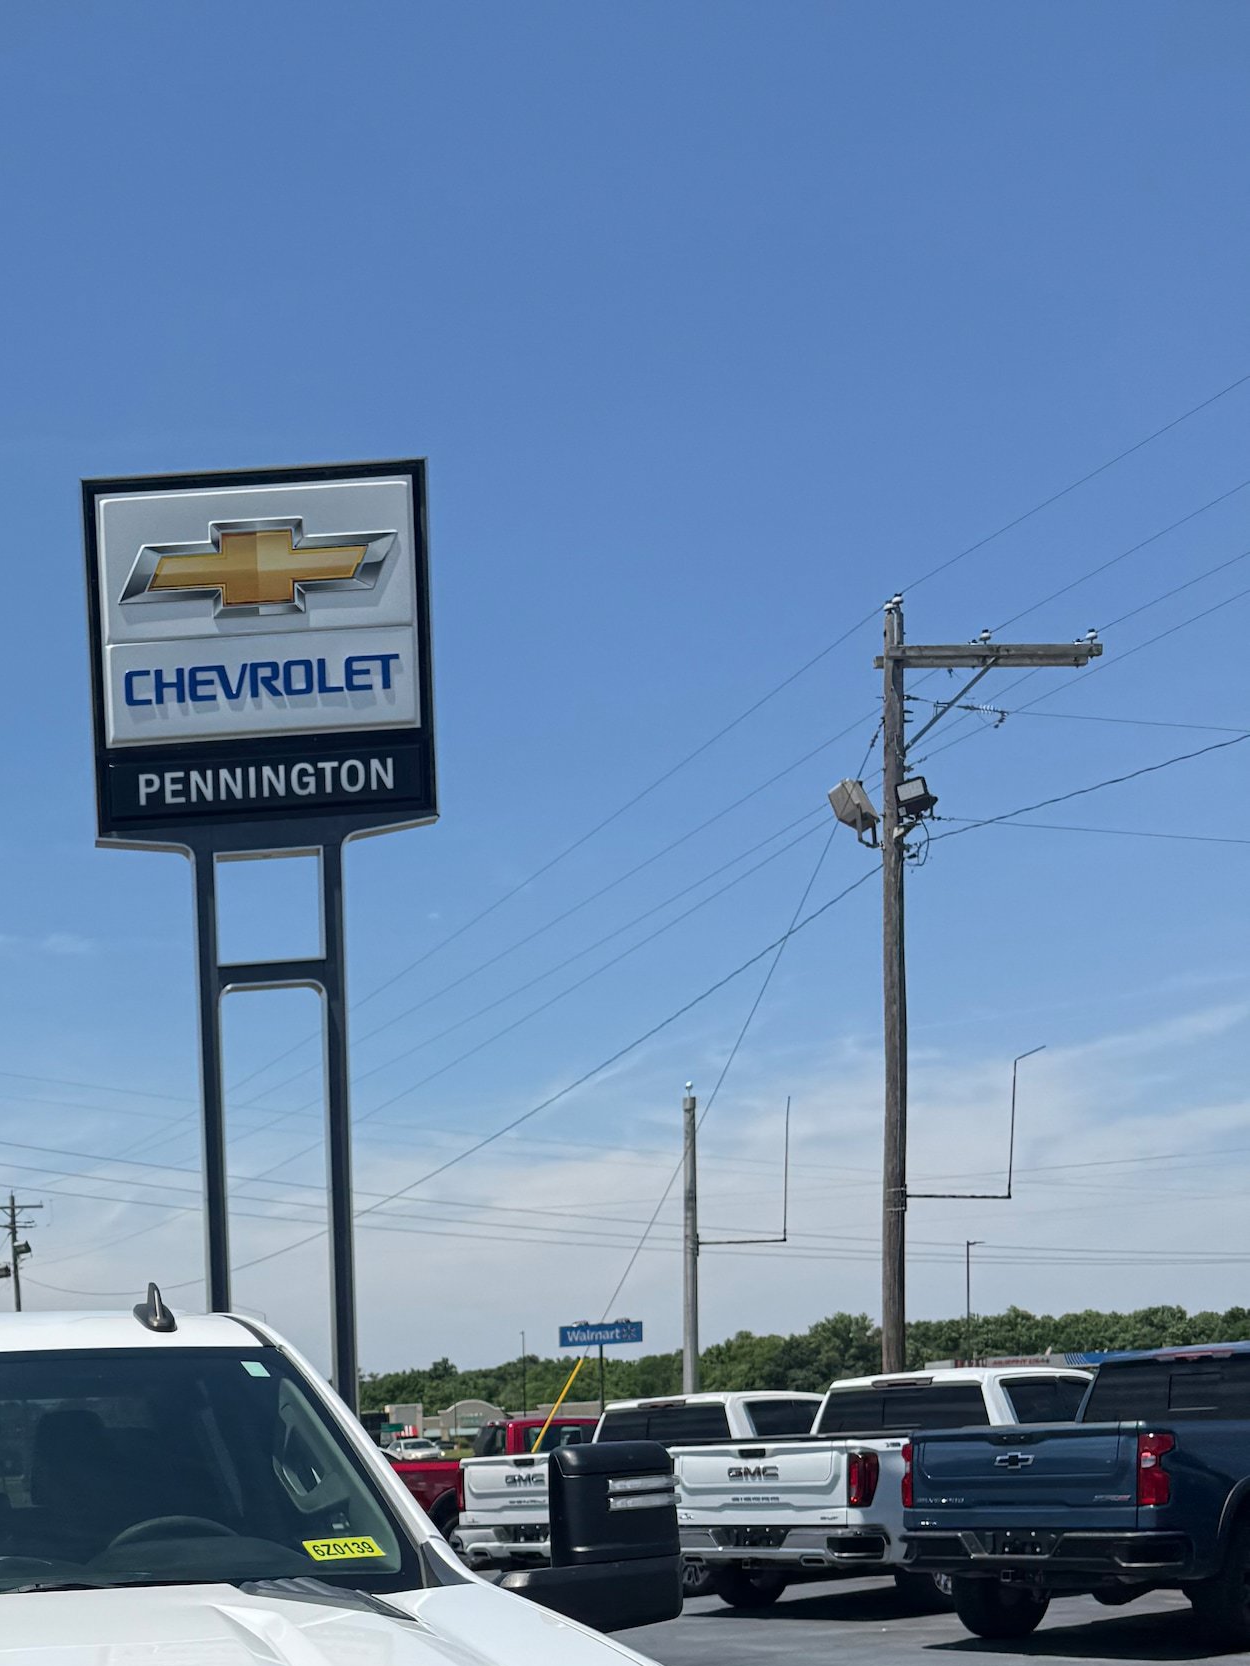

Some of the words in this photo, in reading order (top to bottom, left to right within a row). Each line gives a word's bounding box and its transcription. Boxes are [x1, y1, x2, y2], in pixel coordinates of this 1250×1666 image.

[124, 652, 400, 707] CHEVROLET
[137, 757, 395, 806] PENNINGTON
[566, 1327, 621, 1342] Walmart
[505, 1473, 546, 1486] GMC
[728, 1466, 779, 1480] GMC
[312, 1541, 374, 1557] 6Z0139
